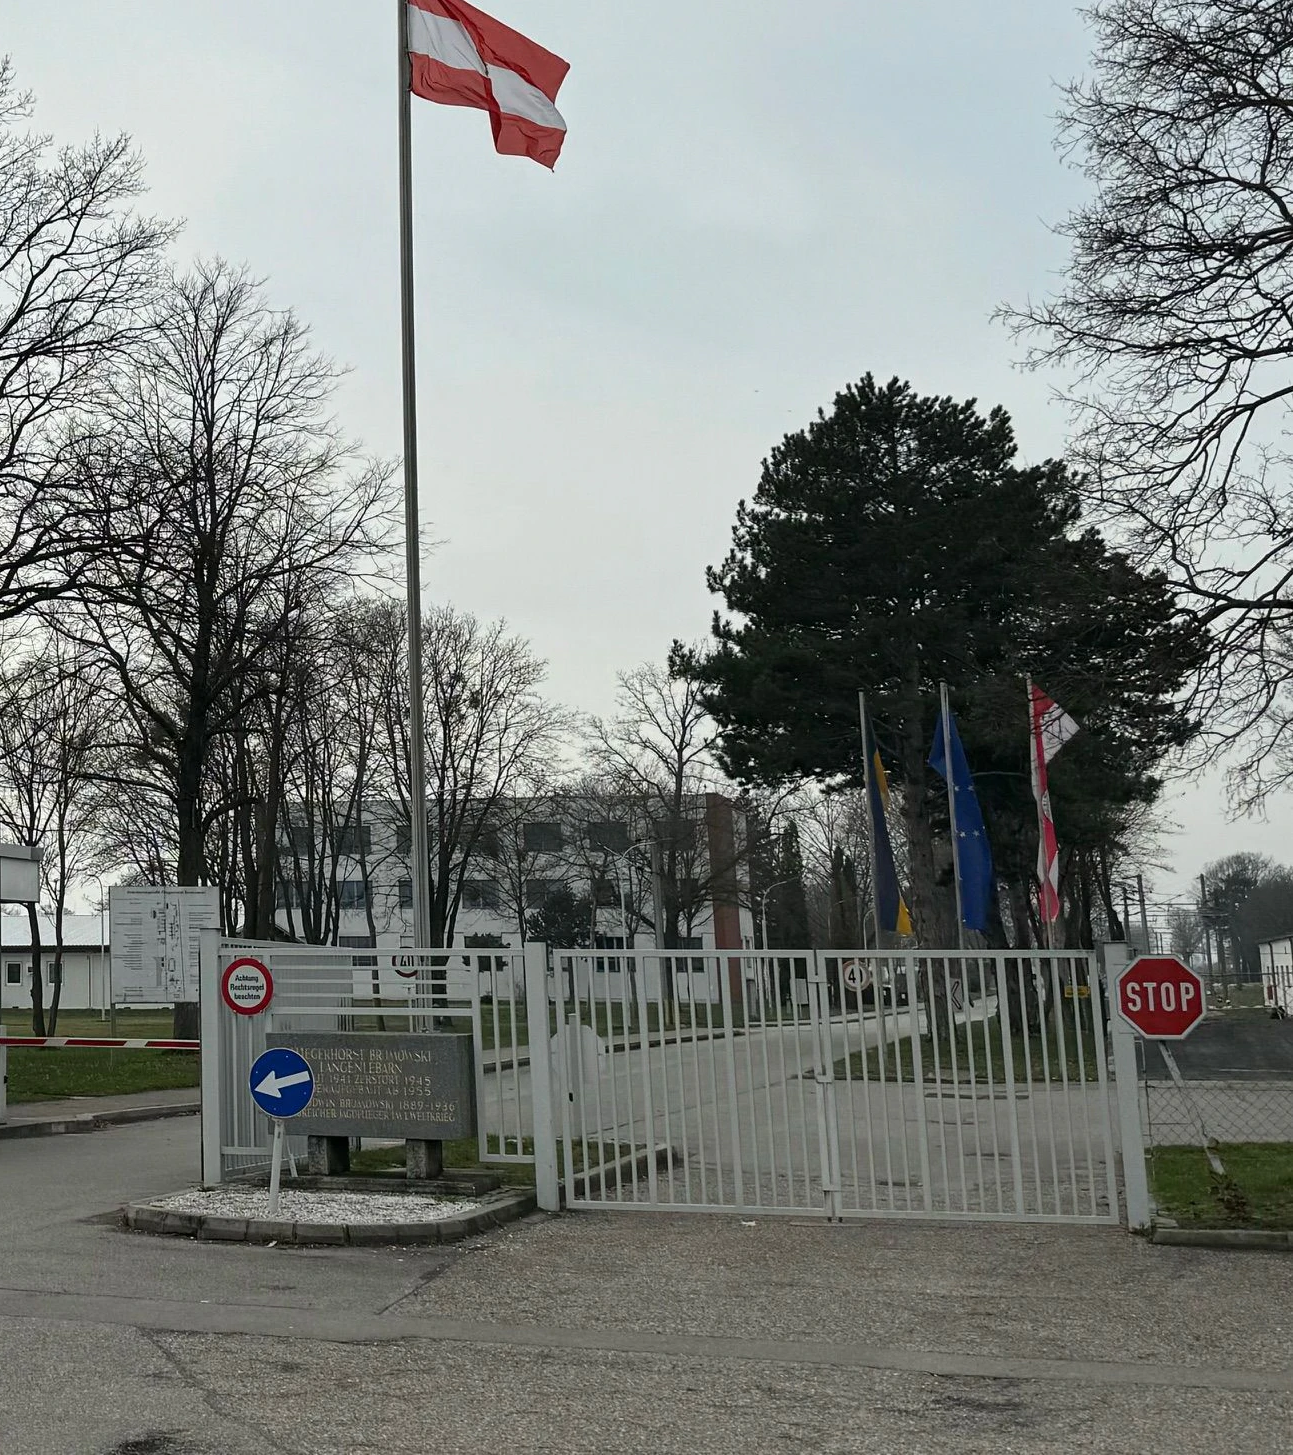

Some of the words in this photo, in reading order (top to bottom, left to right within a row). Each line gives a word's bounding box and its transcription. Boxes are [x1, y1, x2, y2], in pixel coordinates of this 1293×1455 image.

[235, 974, 259, 983] Achtung
[230, 983, 264, 992] Rechtsregel
[1126, 981, 1195, 1012] STOP
[295, 1047, 364, 1061] IEGERHORST
[404, 1075, 432, 1087] 1945
[403, 1086, 431, 1097] 1955
